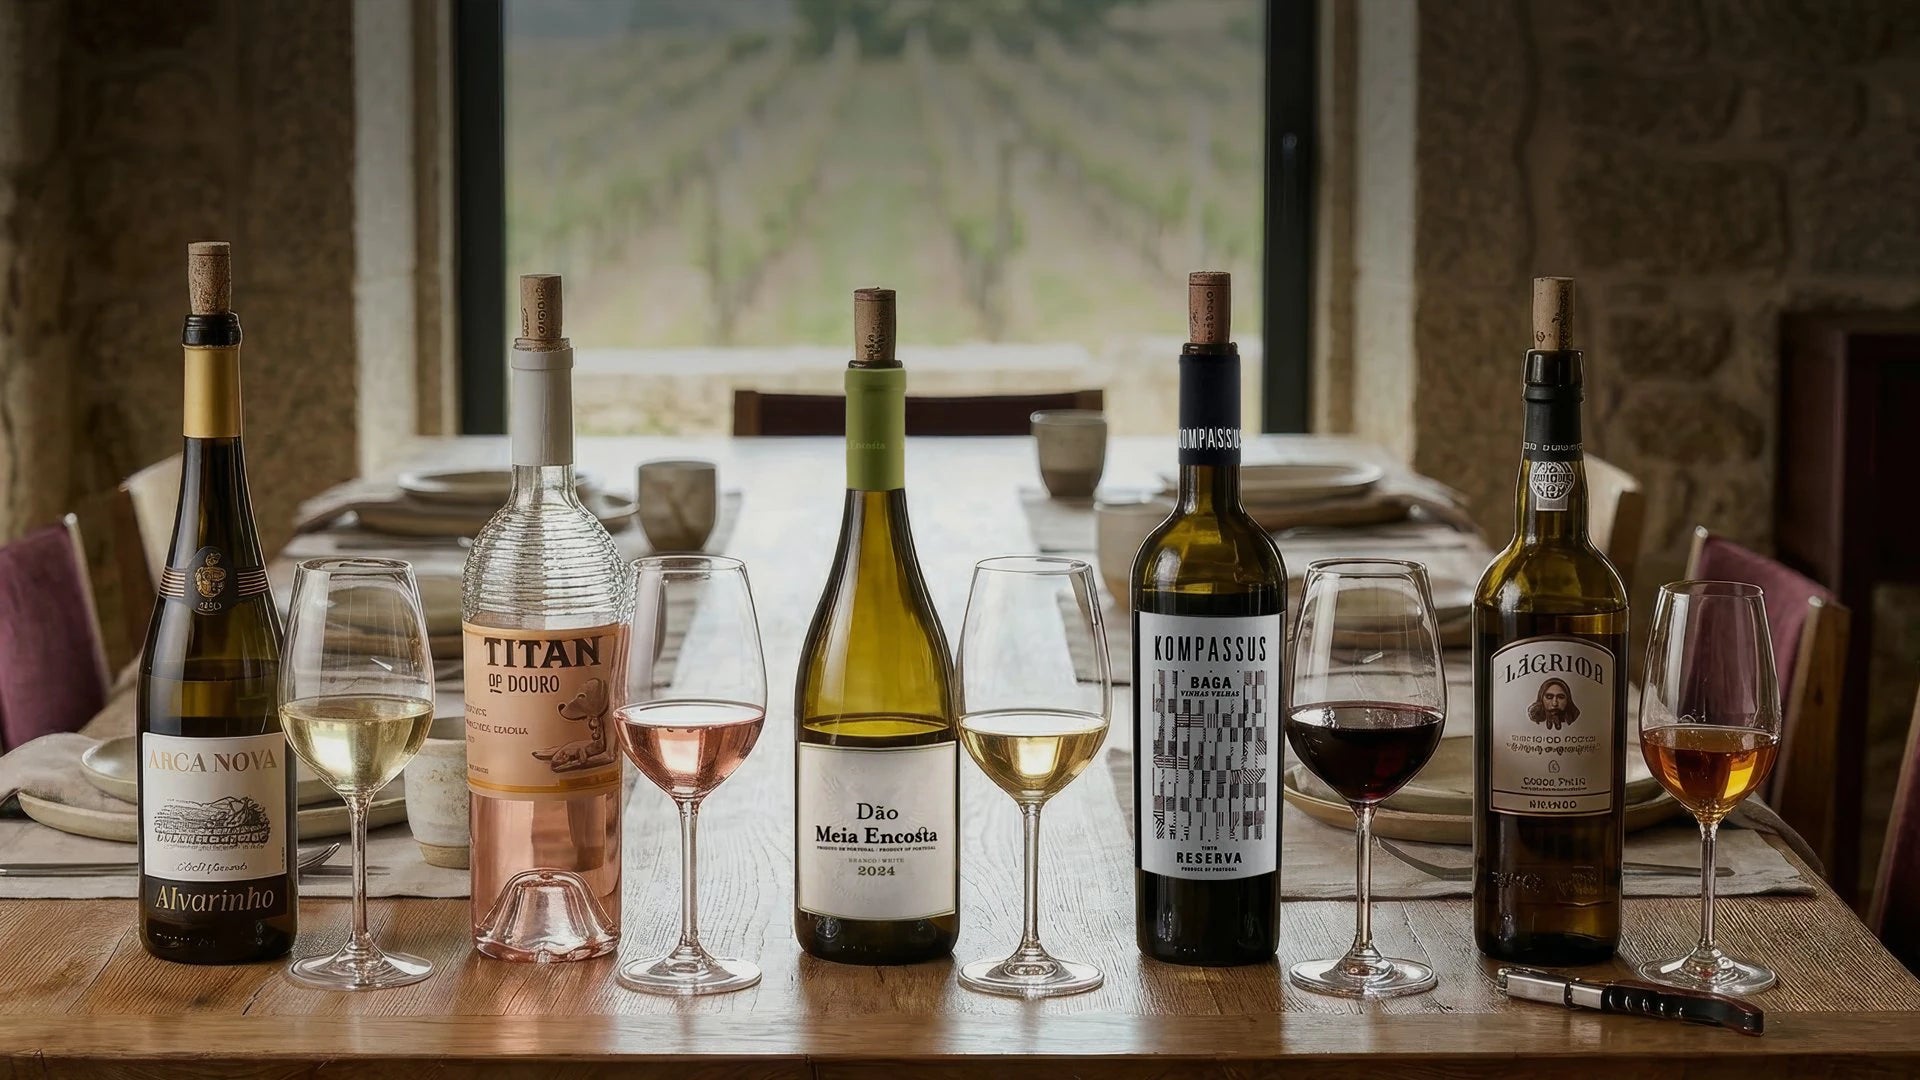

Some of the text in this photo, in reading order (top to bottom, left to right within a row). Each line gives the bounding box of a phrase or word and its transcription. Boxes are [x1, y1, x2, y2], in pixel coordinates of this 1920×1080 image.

[484, 636, 603, 668] TITAN
[1154, 635, 1266, 662] KOMPASSUS
[508, 675, 560, 693] DOURO
[1190, 676, 1232, 689] BAGA
[1180, 690, 1240, 698] VINHAS VELHAS
[149, 749, 277, 773] ARCA NOVA
[856, 802, 899, 820] Dão
[815, 825, 938, 844] Meia Encosta
[1176, 852, 1243, 864] RESERVA
[857, 865, 896, 877] 2024
[155, 884, 275, 913] Alvarinho
